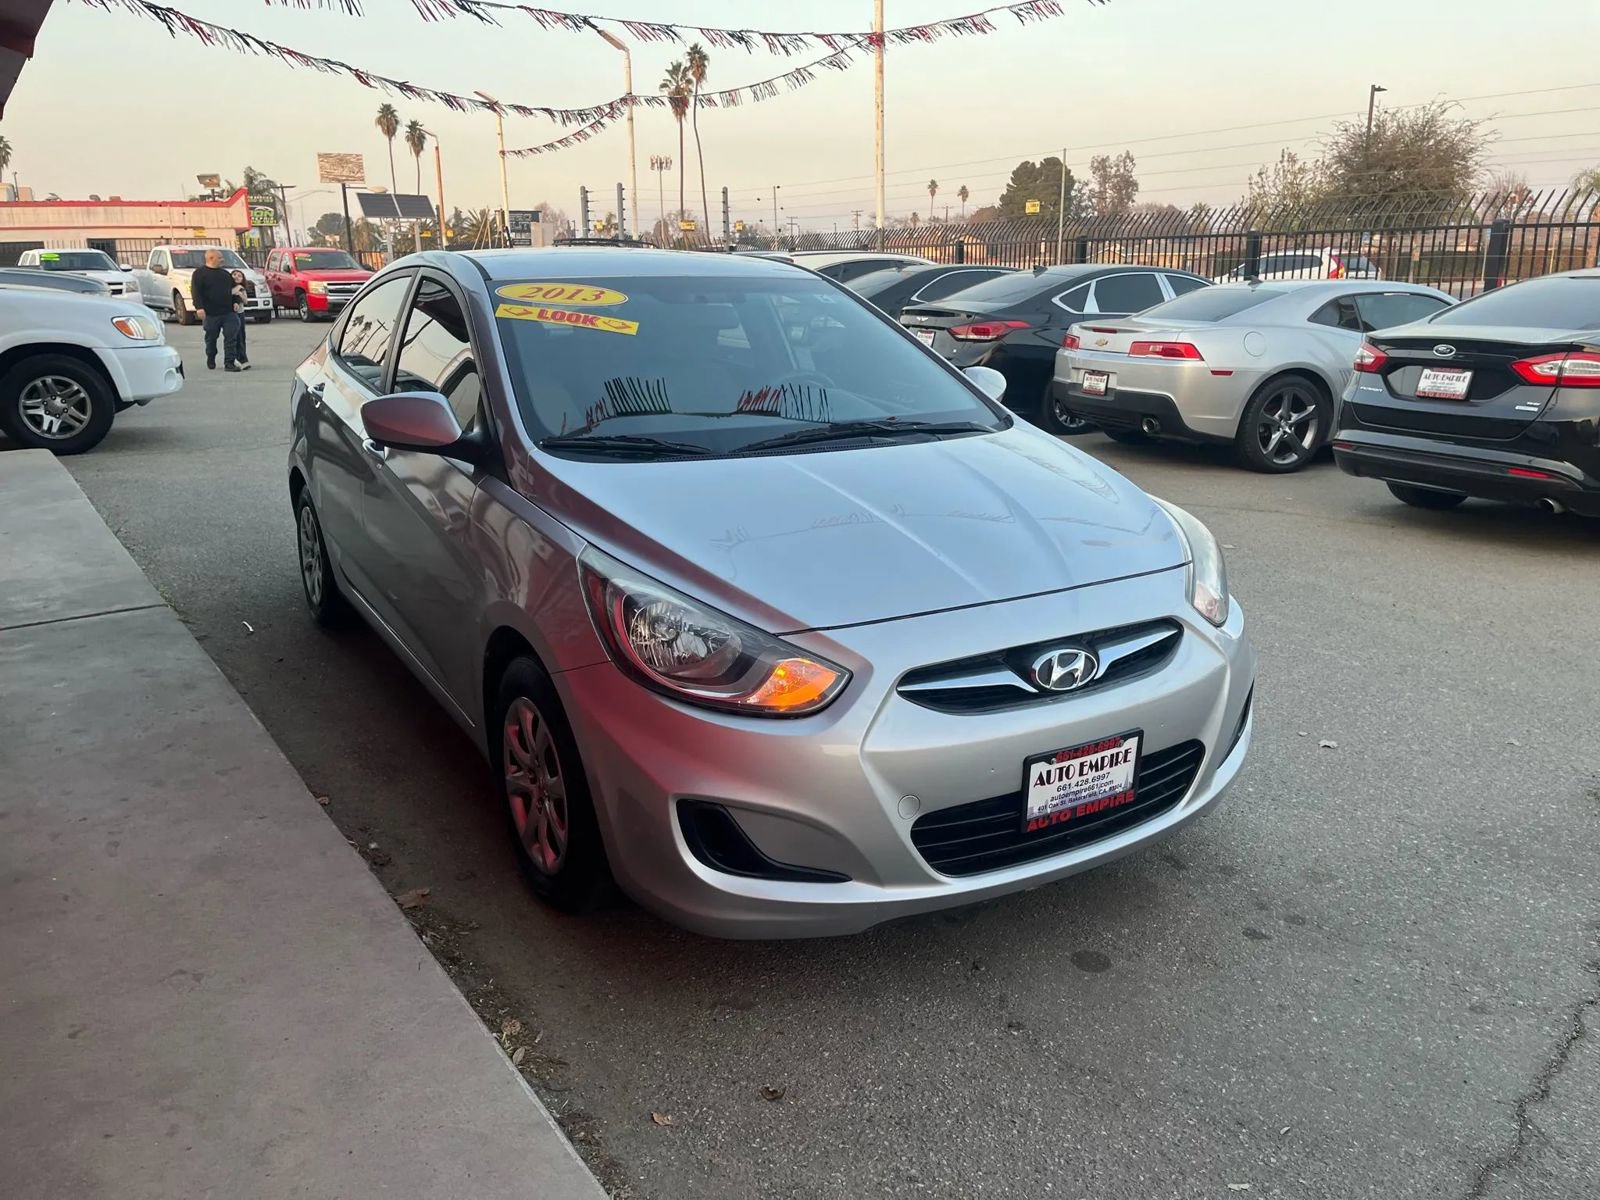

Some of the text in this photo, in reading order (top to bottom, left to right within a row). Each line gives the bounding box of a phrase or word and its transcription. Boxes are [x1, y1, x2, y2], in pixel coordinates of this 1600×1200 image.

[518, 286, 605, 301] 2013
[537, 308, 600, 327] LOOK
[1034, 748, 1132, 787] AUTO EMPIRE
[1050, 780, 1114, 801] autoempire661.com
[1057, 772, 1110, 792] 661.428.6997
[1027, 789, 1135, 832] AUTO EMPIRE
